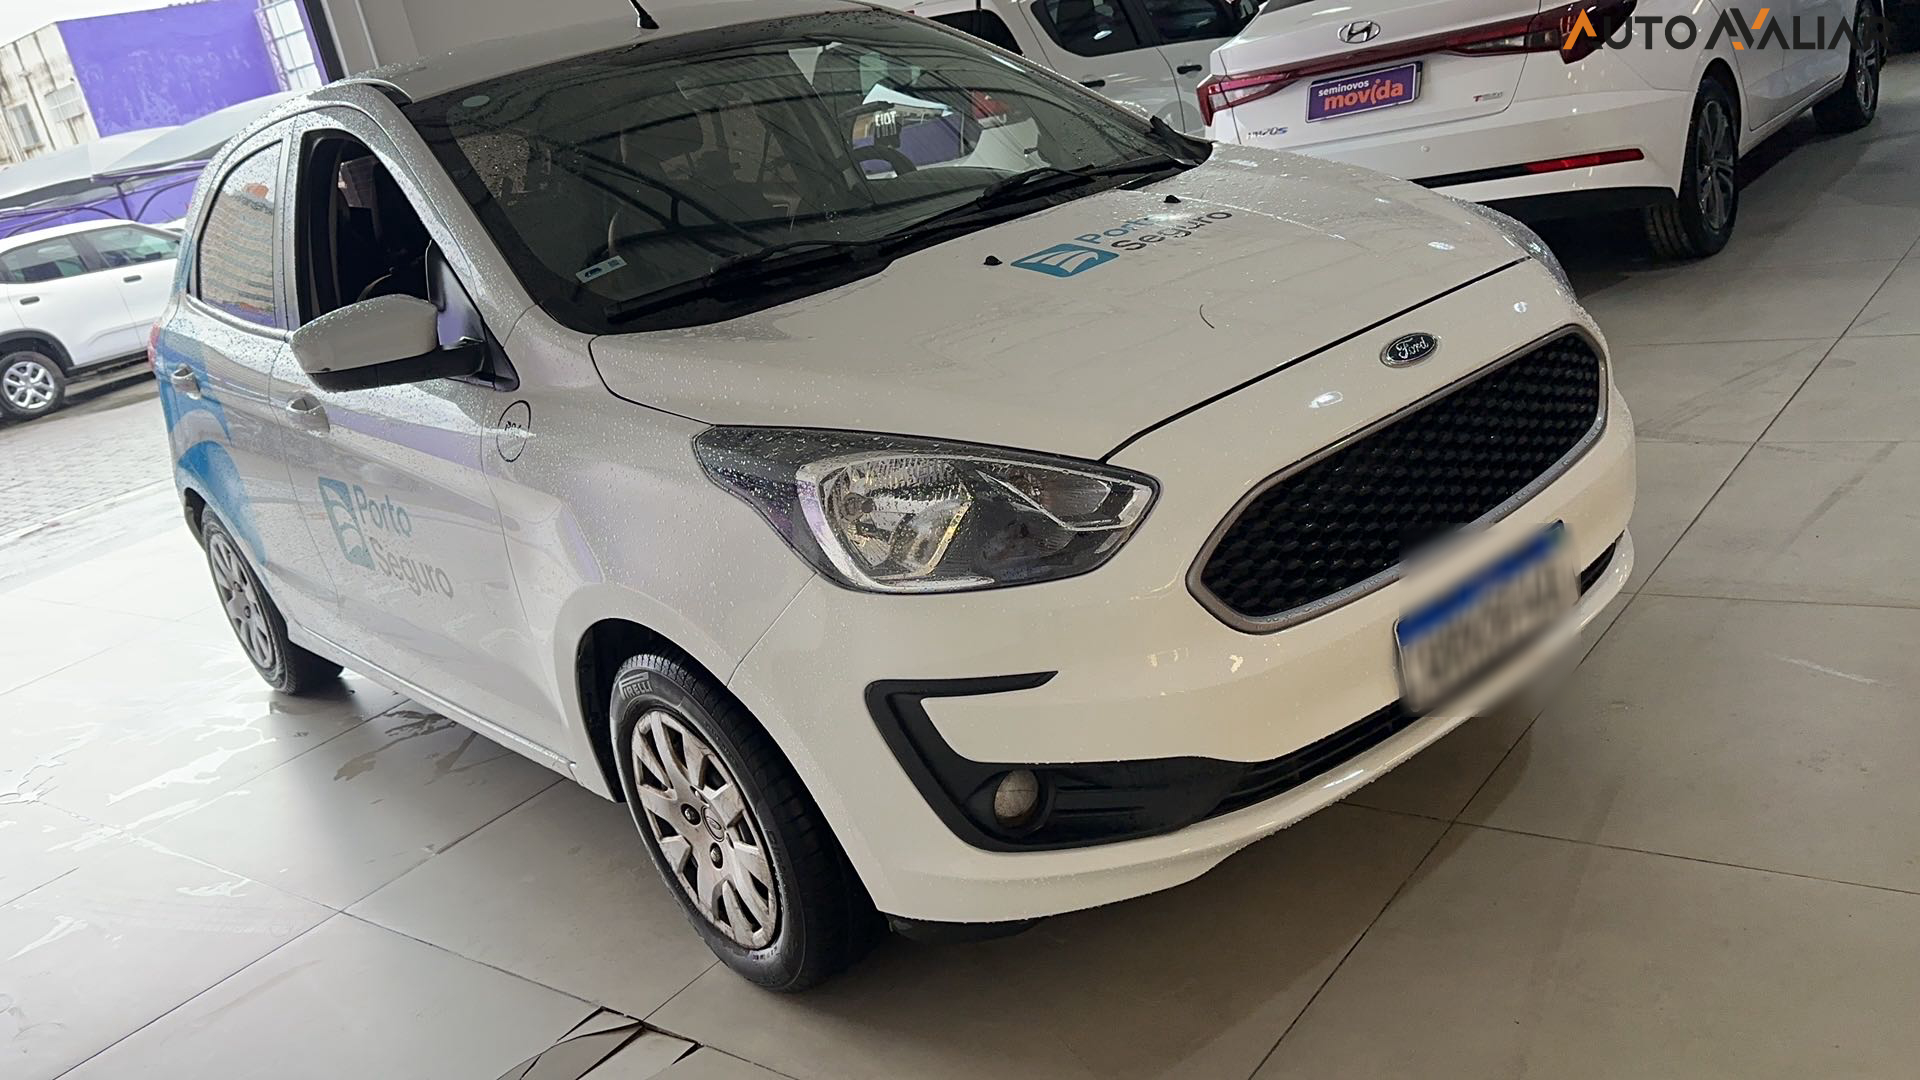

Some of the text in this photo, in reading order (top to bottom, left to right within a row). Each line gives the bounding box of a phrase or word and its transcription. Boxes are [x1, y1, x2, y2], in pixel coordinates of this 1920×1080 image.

[1318, 80, 1369, 97] seminovos
[1324, 79, 1404, 112] movida
[1110, 211, 1233, 251] Seguro
[1395, 336, 1430, 359] Ford
[352, 484, 412, 538] Porto
[368, 536, 454, 599] Seguro
[618, 671, 653, 701] PIRELLI
